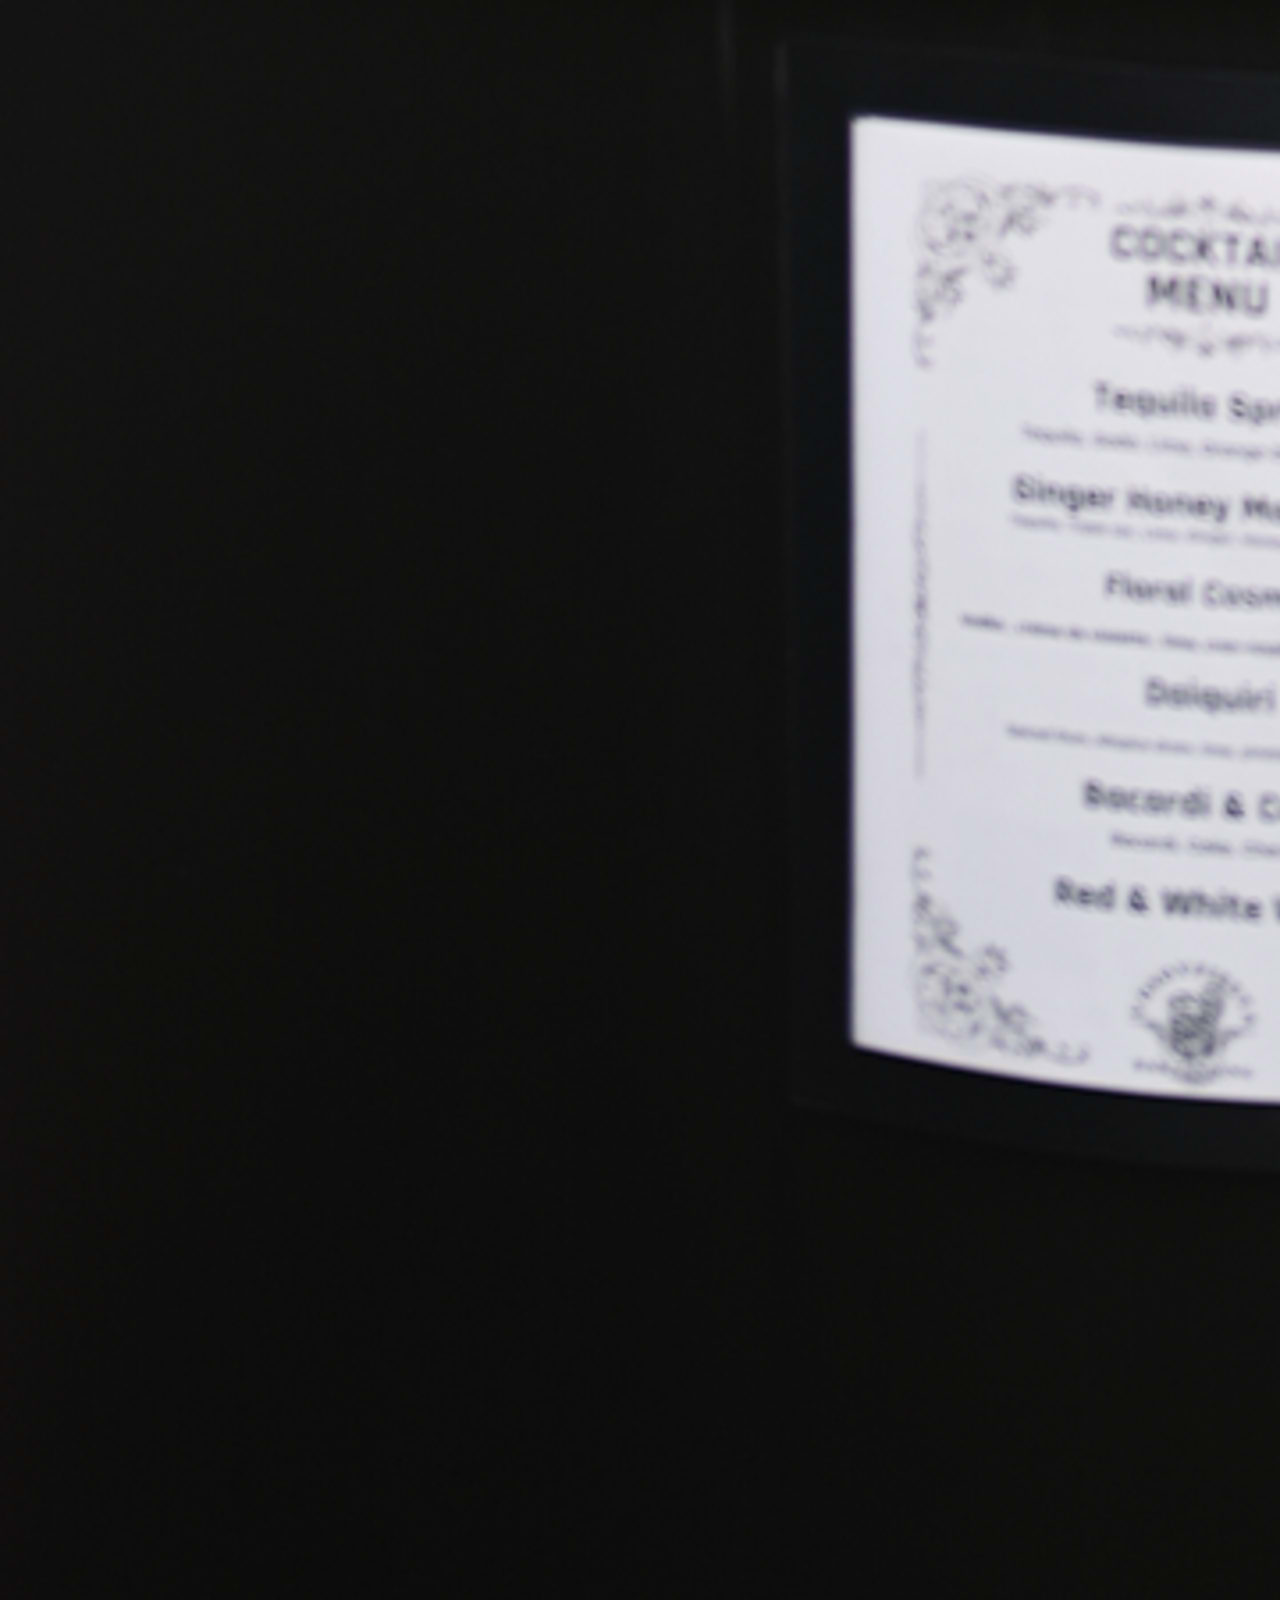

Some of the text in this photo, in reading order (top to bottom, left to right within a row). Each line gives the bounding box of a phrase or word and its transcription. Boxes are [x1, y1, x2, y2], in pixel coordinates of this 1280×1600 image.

[1147, 277, 1269, 317] MENU
[1095, 381, 1215, 422] Tequila
[1013, 475, 1113, 512] Ginger
[1128, 487, 1228, 522] Honey
[1105, 572, 1194, 604] Floral
[1145, 677, 1275, 714] Daiquiri
[1083, 780, 1210, 816] Bacardi
[1225, 792, 1245, 818] &
[1054, 876, 1115, 911] Red
[1128, 886, 1149, 914] &
[1161, 888, 1261, 920] White
